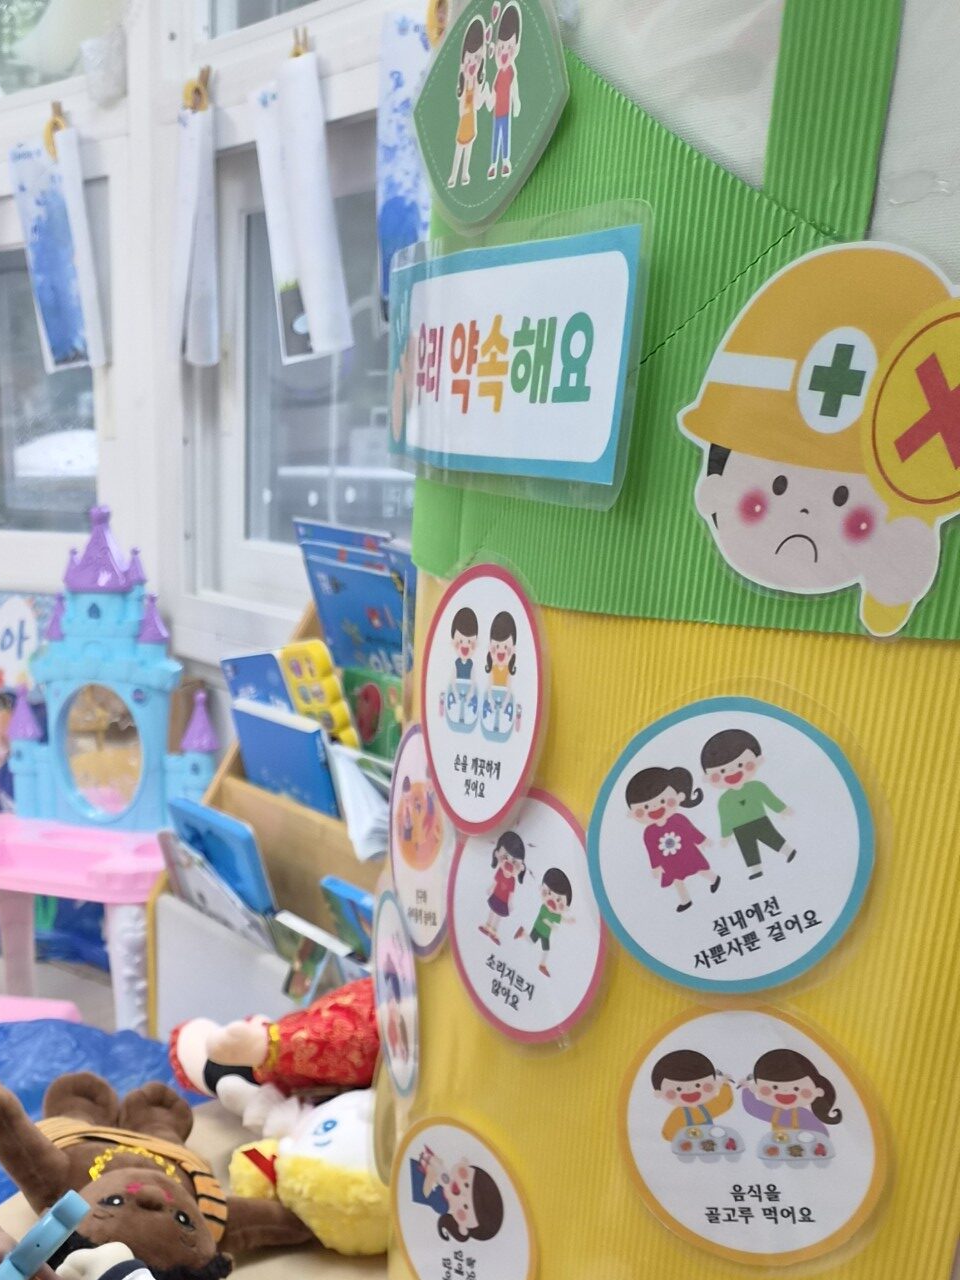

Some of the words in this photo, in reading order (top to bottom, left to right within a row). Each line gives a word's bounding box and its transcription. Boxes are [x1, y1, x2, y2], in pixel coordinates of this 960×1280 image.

[416, 322, 444, 405] 우리
[450, 311, 594, 414] 약속해요
[453, 753, 468, 773] 손을
[471, 757, 501, 780] 깨끗하게
[464, 779, 485, 798] 씻어요
[713, 896, 782, 937] 실내에선
[694, 931, 761, 970] 사뿐사뿐
[767, 909, 822, 943] 걸어요
[485, 953, 536, 1001] 소리지르지
[490, 978, 520, 1011] 않아요
[729, 1183, 781, 1202] 음식을
[704, 1207, 754, 1225] 골고루
[762, 1206, 816, 1225] 먹어요
[454, 1250, 465, 1276] 입에
